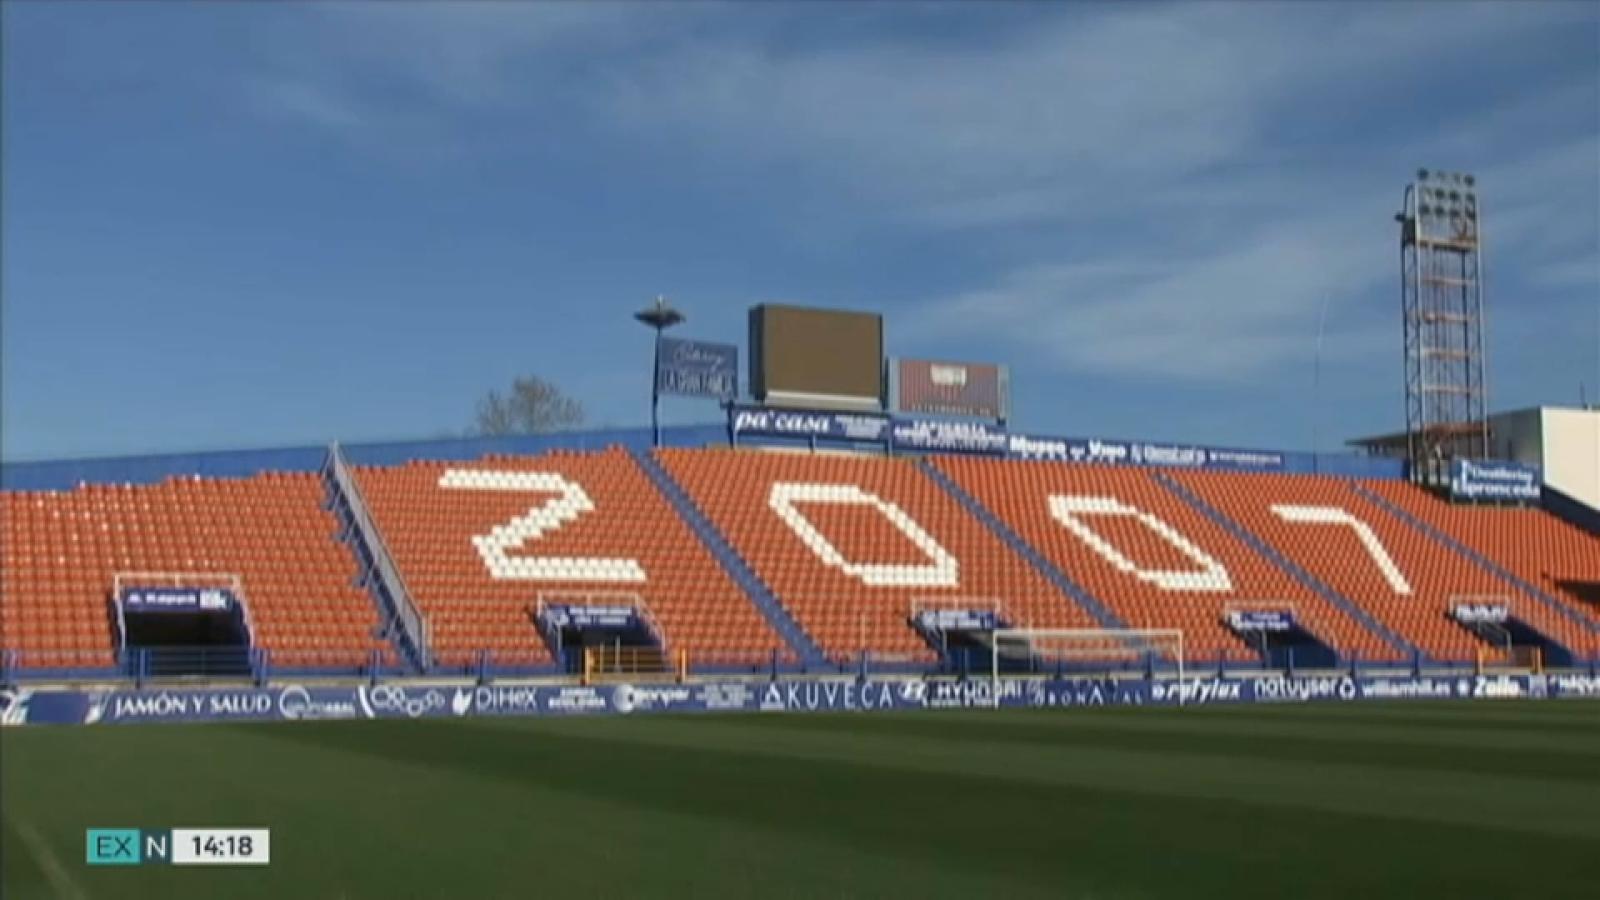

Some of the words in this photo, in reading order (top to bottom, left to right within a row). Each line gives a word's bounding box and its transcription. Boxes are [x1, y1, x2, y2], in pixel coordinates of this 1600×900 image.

[775, 414, 830, 434] casa
[114, 690, 187, 718] JAMÓN
[192, 695, 206, 714] Y
[210, 693, 272, 715] SALUD
